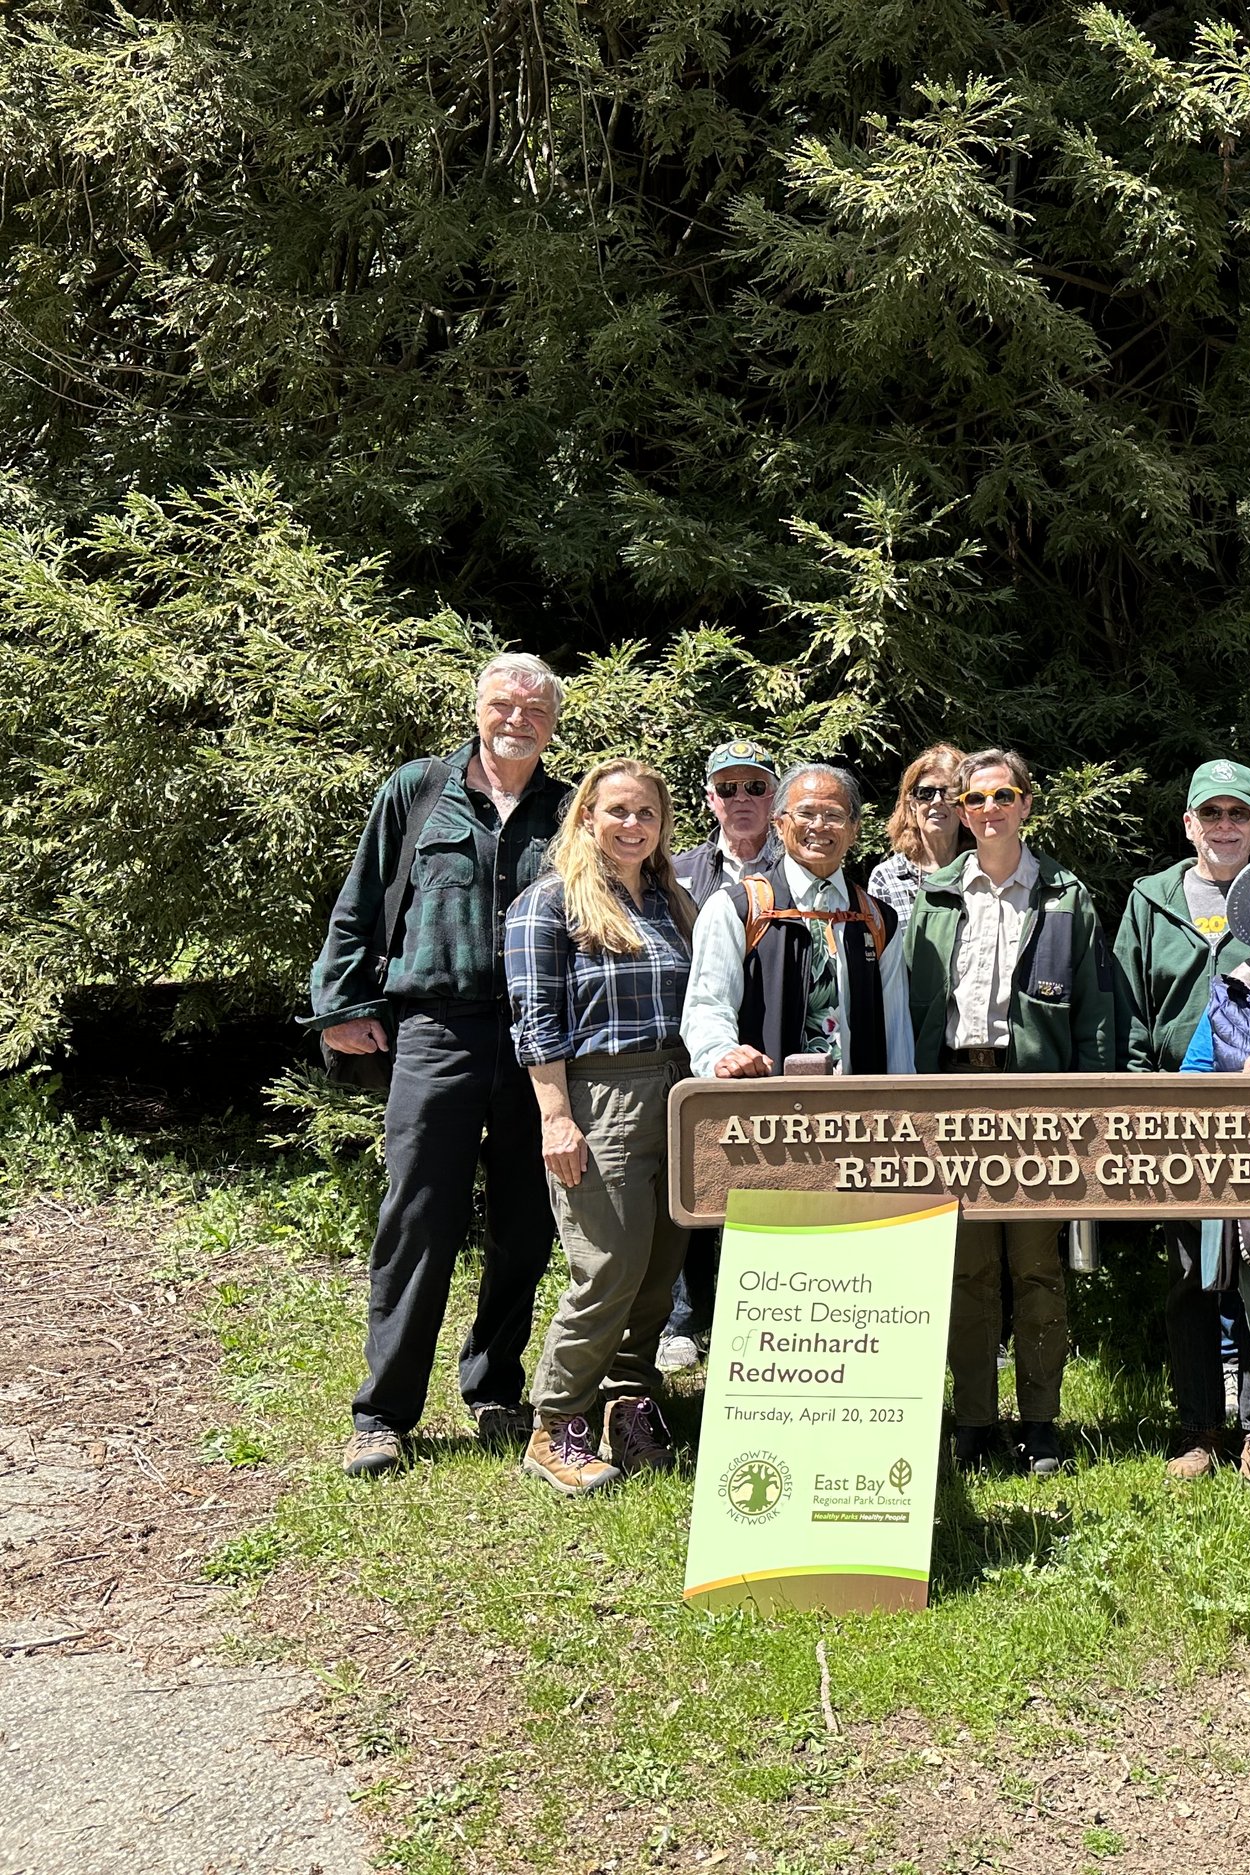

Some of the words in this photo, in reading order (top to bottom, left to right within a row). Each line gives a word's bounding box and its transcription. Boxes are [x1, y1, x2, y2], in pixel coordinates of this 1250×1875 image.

[719, 1115, 921, 1144] AURELIA
[935, 1113, 1092, 1142] HENRY
[835, 1156, 1081, 1188] REDWOOD
[739, 1271, 872, 1293] Old-Growth
[736, 1301, 802, 1321] Forest
[811, 1302, 930, 1329] Designation
[731, 1329, 757, 1357] of
[759, 1332, 879, 1354] Reinhardt
[729, 1362, 845, 1384] Redwood
[724, 1407, 793, 1425] Thursday,
[799, 1408, 836, 1425] April
[841, 1409, 863, 1424] 20,
[869, 1409, 904, 1423] 2023
[718, 1450, 777, 1497] OLD-GROWTH
[777, 1460, 793, 1501] FOREST
[815, 1474, 849, 1490] East
[856, 1475, 885, 1496] Bay
[813, 1495, 851, 1507] Regional
[854, 1496, 874, 1505] Park
[877, 1496, 911, 1505] District
[726, 1508, 780, 1526] NETWORK
[813, 1513, 839, 1521] Healthy
[859, 1514, 883, 1522] Healthy
[884, 1514, 907, 1522] People
